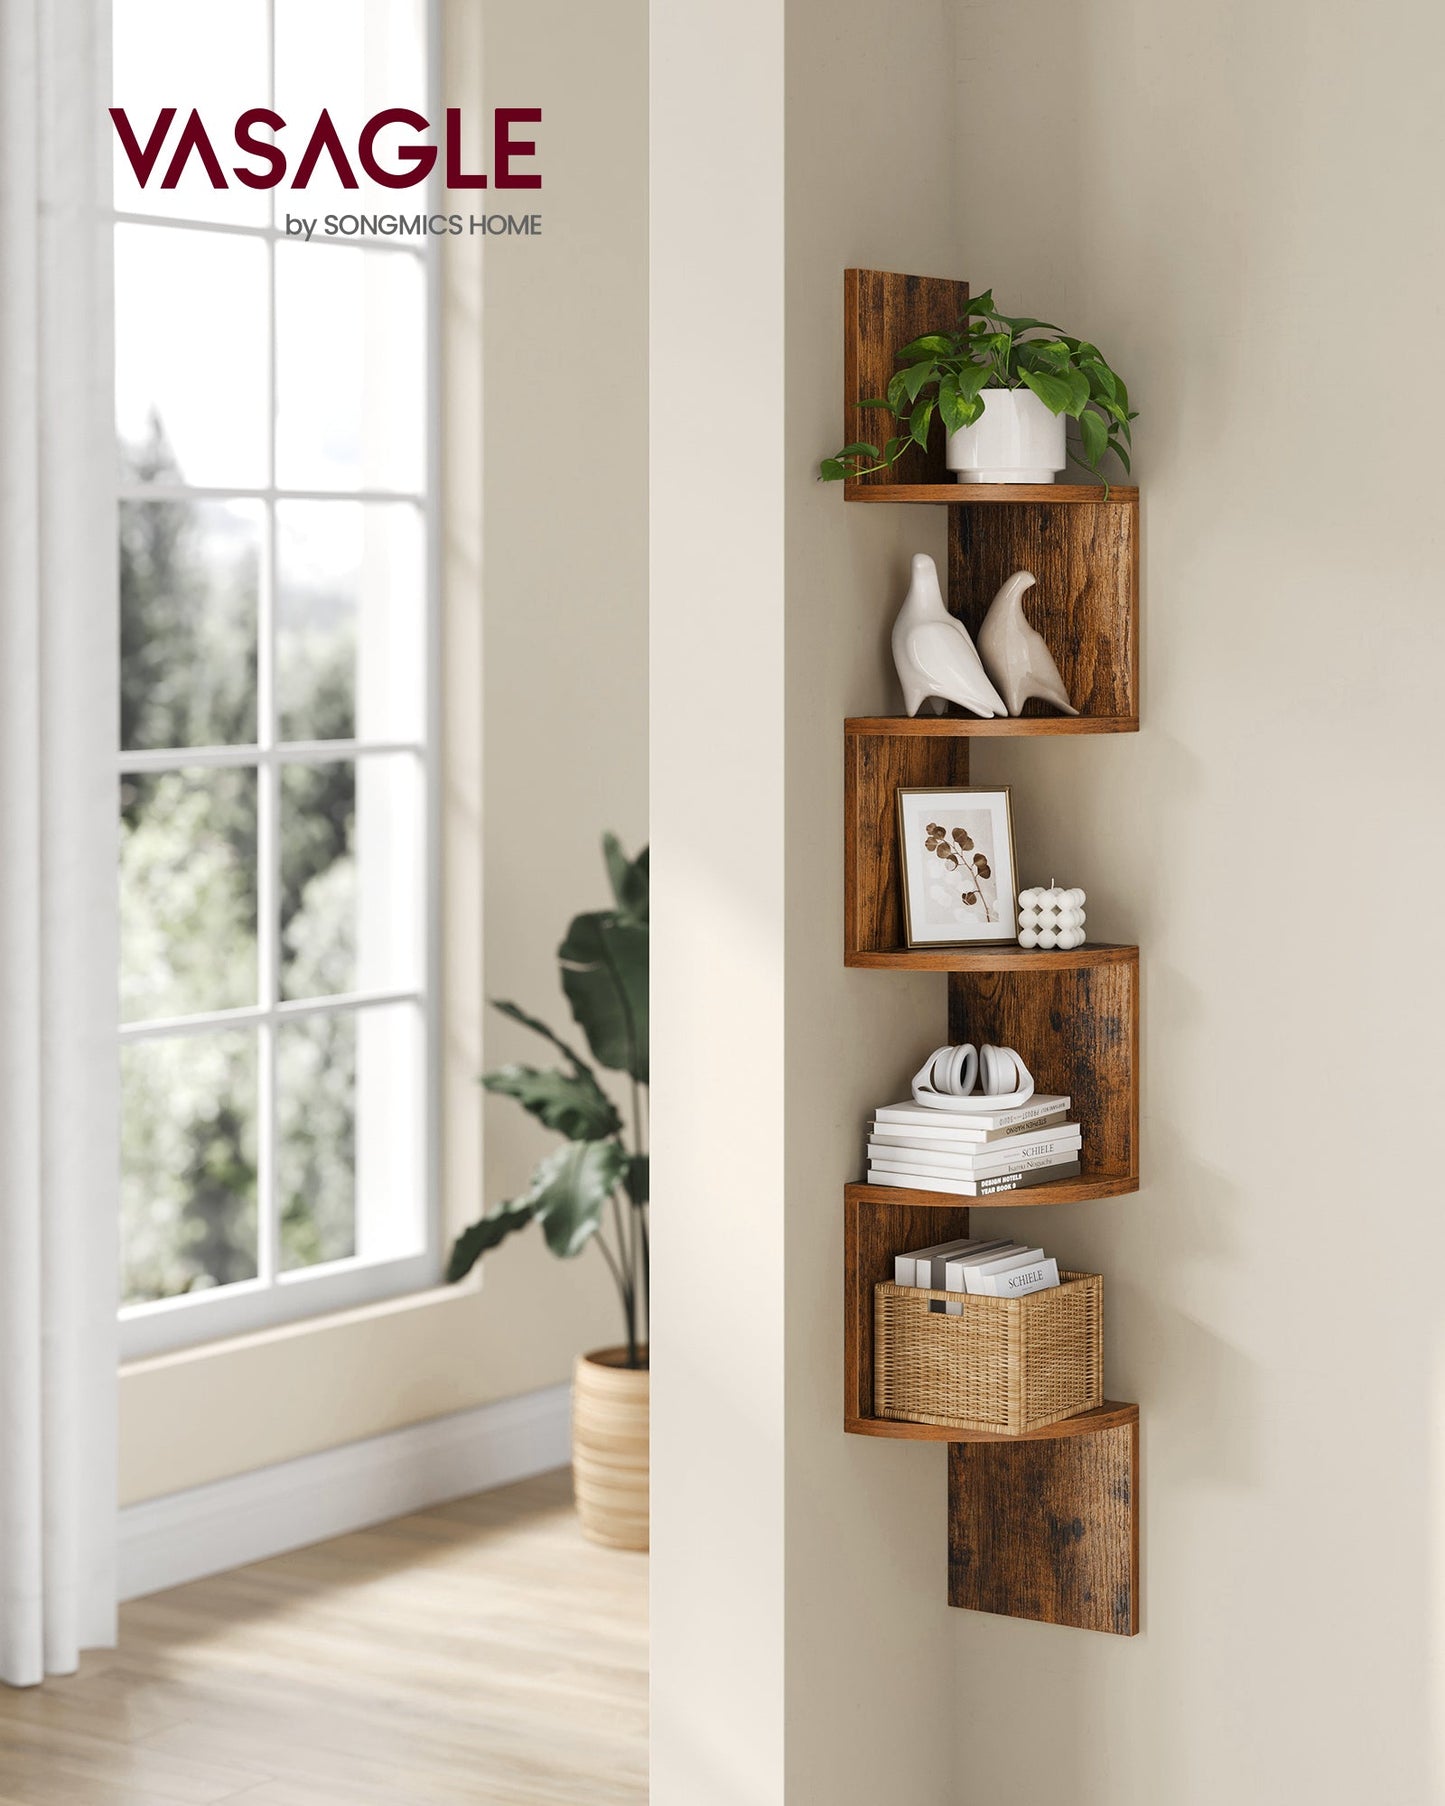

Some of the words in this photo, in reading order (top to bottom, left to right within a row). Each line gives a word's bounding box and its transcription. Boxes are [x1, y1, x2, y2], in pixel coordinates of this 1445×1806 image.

[1025, 1118, 1047, 1129] STEPHEN
[1022, 1144, 1054, 1158] SCHIELE
[1008, 1162, 1027, 1173] Isamu
[1027, 1158, 1052, 1169] Noguchi
[981, 1178, 1002, 1188] DESIGN
[1002, 1173, 1023, 1184] HOTELS
[981, 1186, 996, 1196] YEAR
[996, 1183, 1012, 1193] BOOK
[1008, 1269, 1043, 1289] SCHIELE
